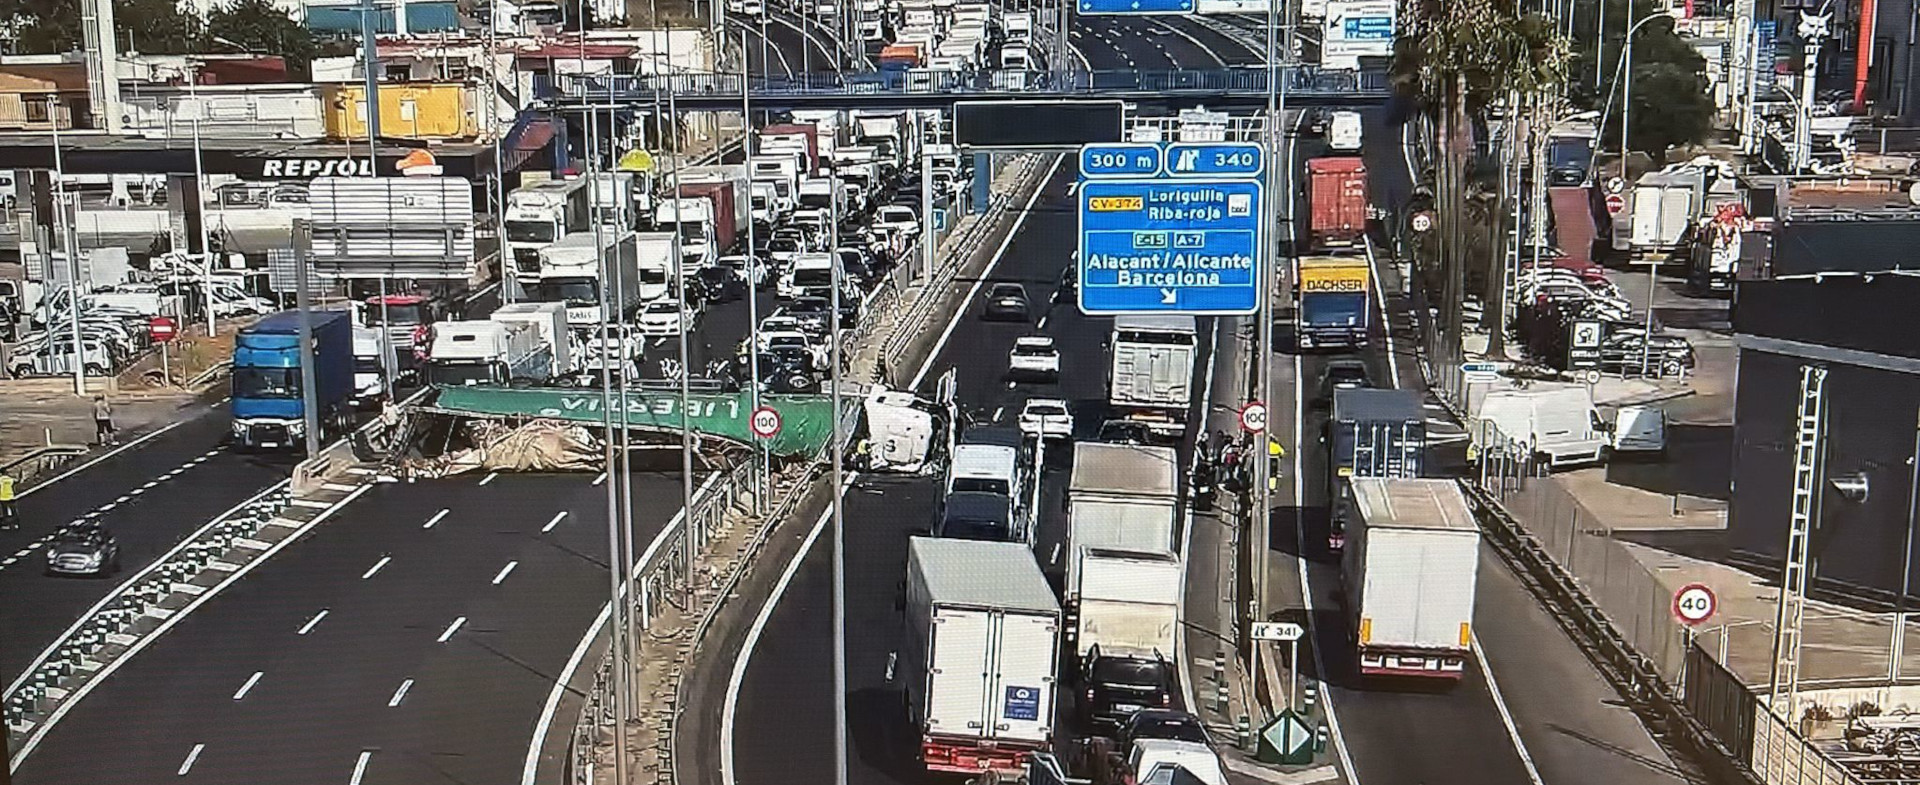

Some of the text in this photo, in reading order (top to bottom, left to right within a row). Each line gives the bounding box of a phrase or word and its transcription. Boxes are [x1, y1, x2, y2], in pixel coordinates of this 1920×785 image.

[1090, 153, 1152, 168] 300 m
[1215, 153, 1253, 166] 340
[262, 159, 372, 177] REPSOL
[1150, 189, 1224, 205] Loriguilla
[1150, 207, 1221, 221] Riba-roja
[1136, 234, 1165, 245] E-15
[1177, 234, 1201, 245] A-7
[1118, 270, 1220, 286] Barcelona
[1307, 280, 1362, 291] DACHSER
[756, 417, 775, 428] 100
[1246, 413, 1266, 424] 100
[1681, 597, 1707, 610] 40
[1276, 627, 1296, 637] 341
